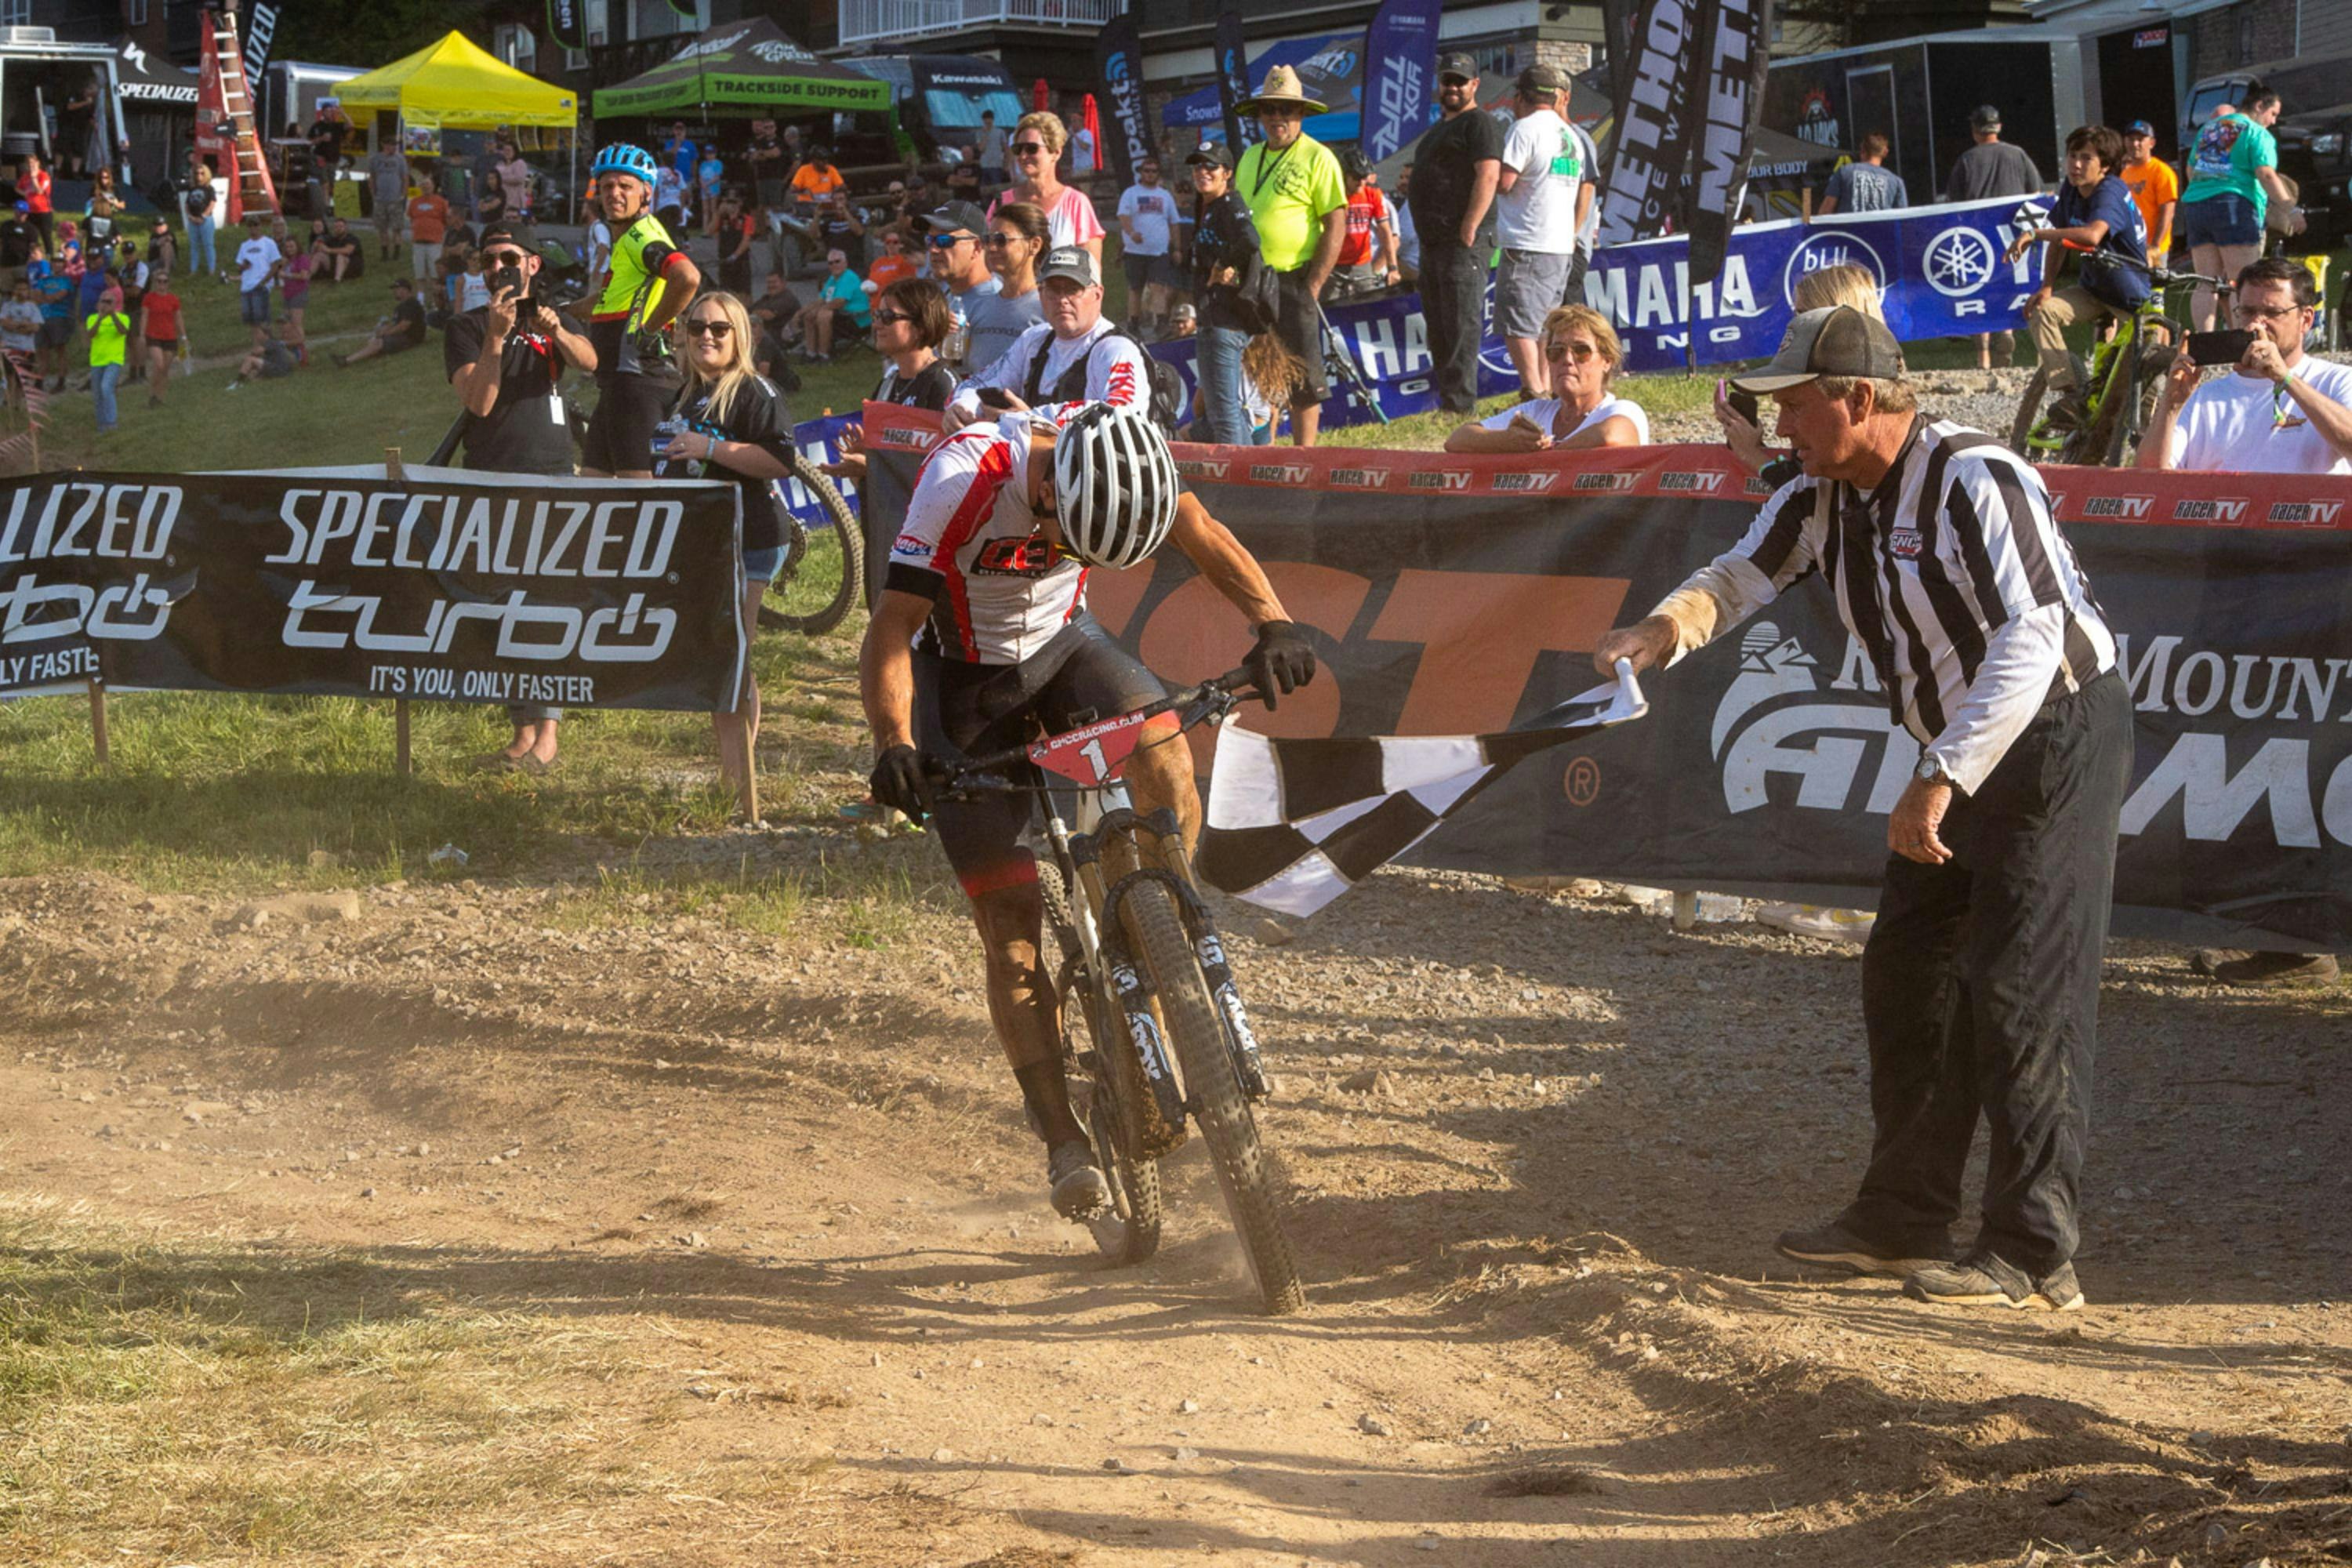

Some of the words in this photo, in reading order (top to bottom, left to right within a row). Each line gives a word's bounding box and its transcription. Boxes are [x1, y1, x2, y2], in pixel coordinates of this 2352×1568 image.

[715, 81, 801, 95] TRACKSIDE
[807, 85, 879, 100] SUPPORT
[931, 74, 1003, 85] Kawasaki
[1697, 0, 1748, 214] MET
[1775, 161, 1809, 176] BODY
[265, 488, 684, 579] SPECIALIZED
[0, 573, 172, 644] bo
[281, 579, 678, 662] turbo
[370, 666, 406, 692] IT'S
[413, 667, 456, 699] YOU,
[463, 670, 514, 699] ONLY
[518, 673, 594, 703] FASTER
[1079, 738, 1110, 782] 1
